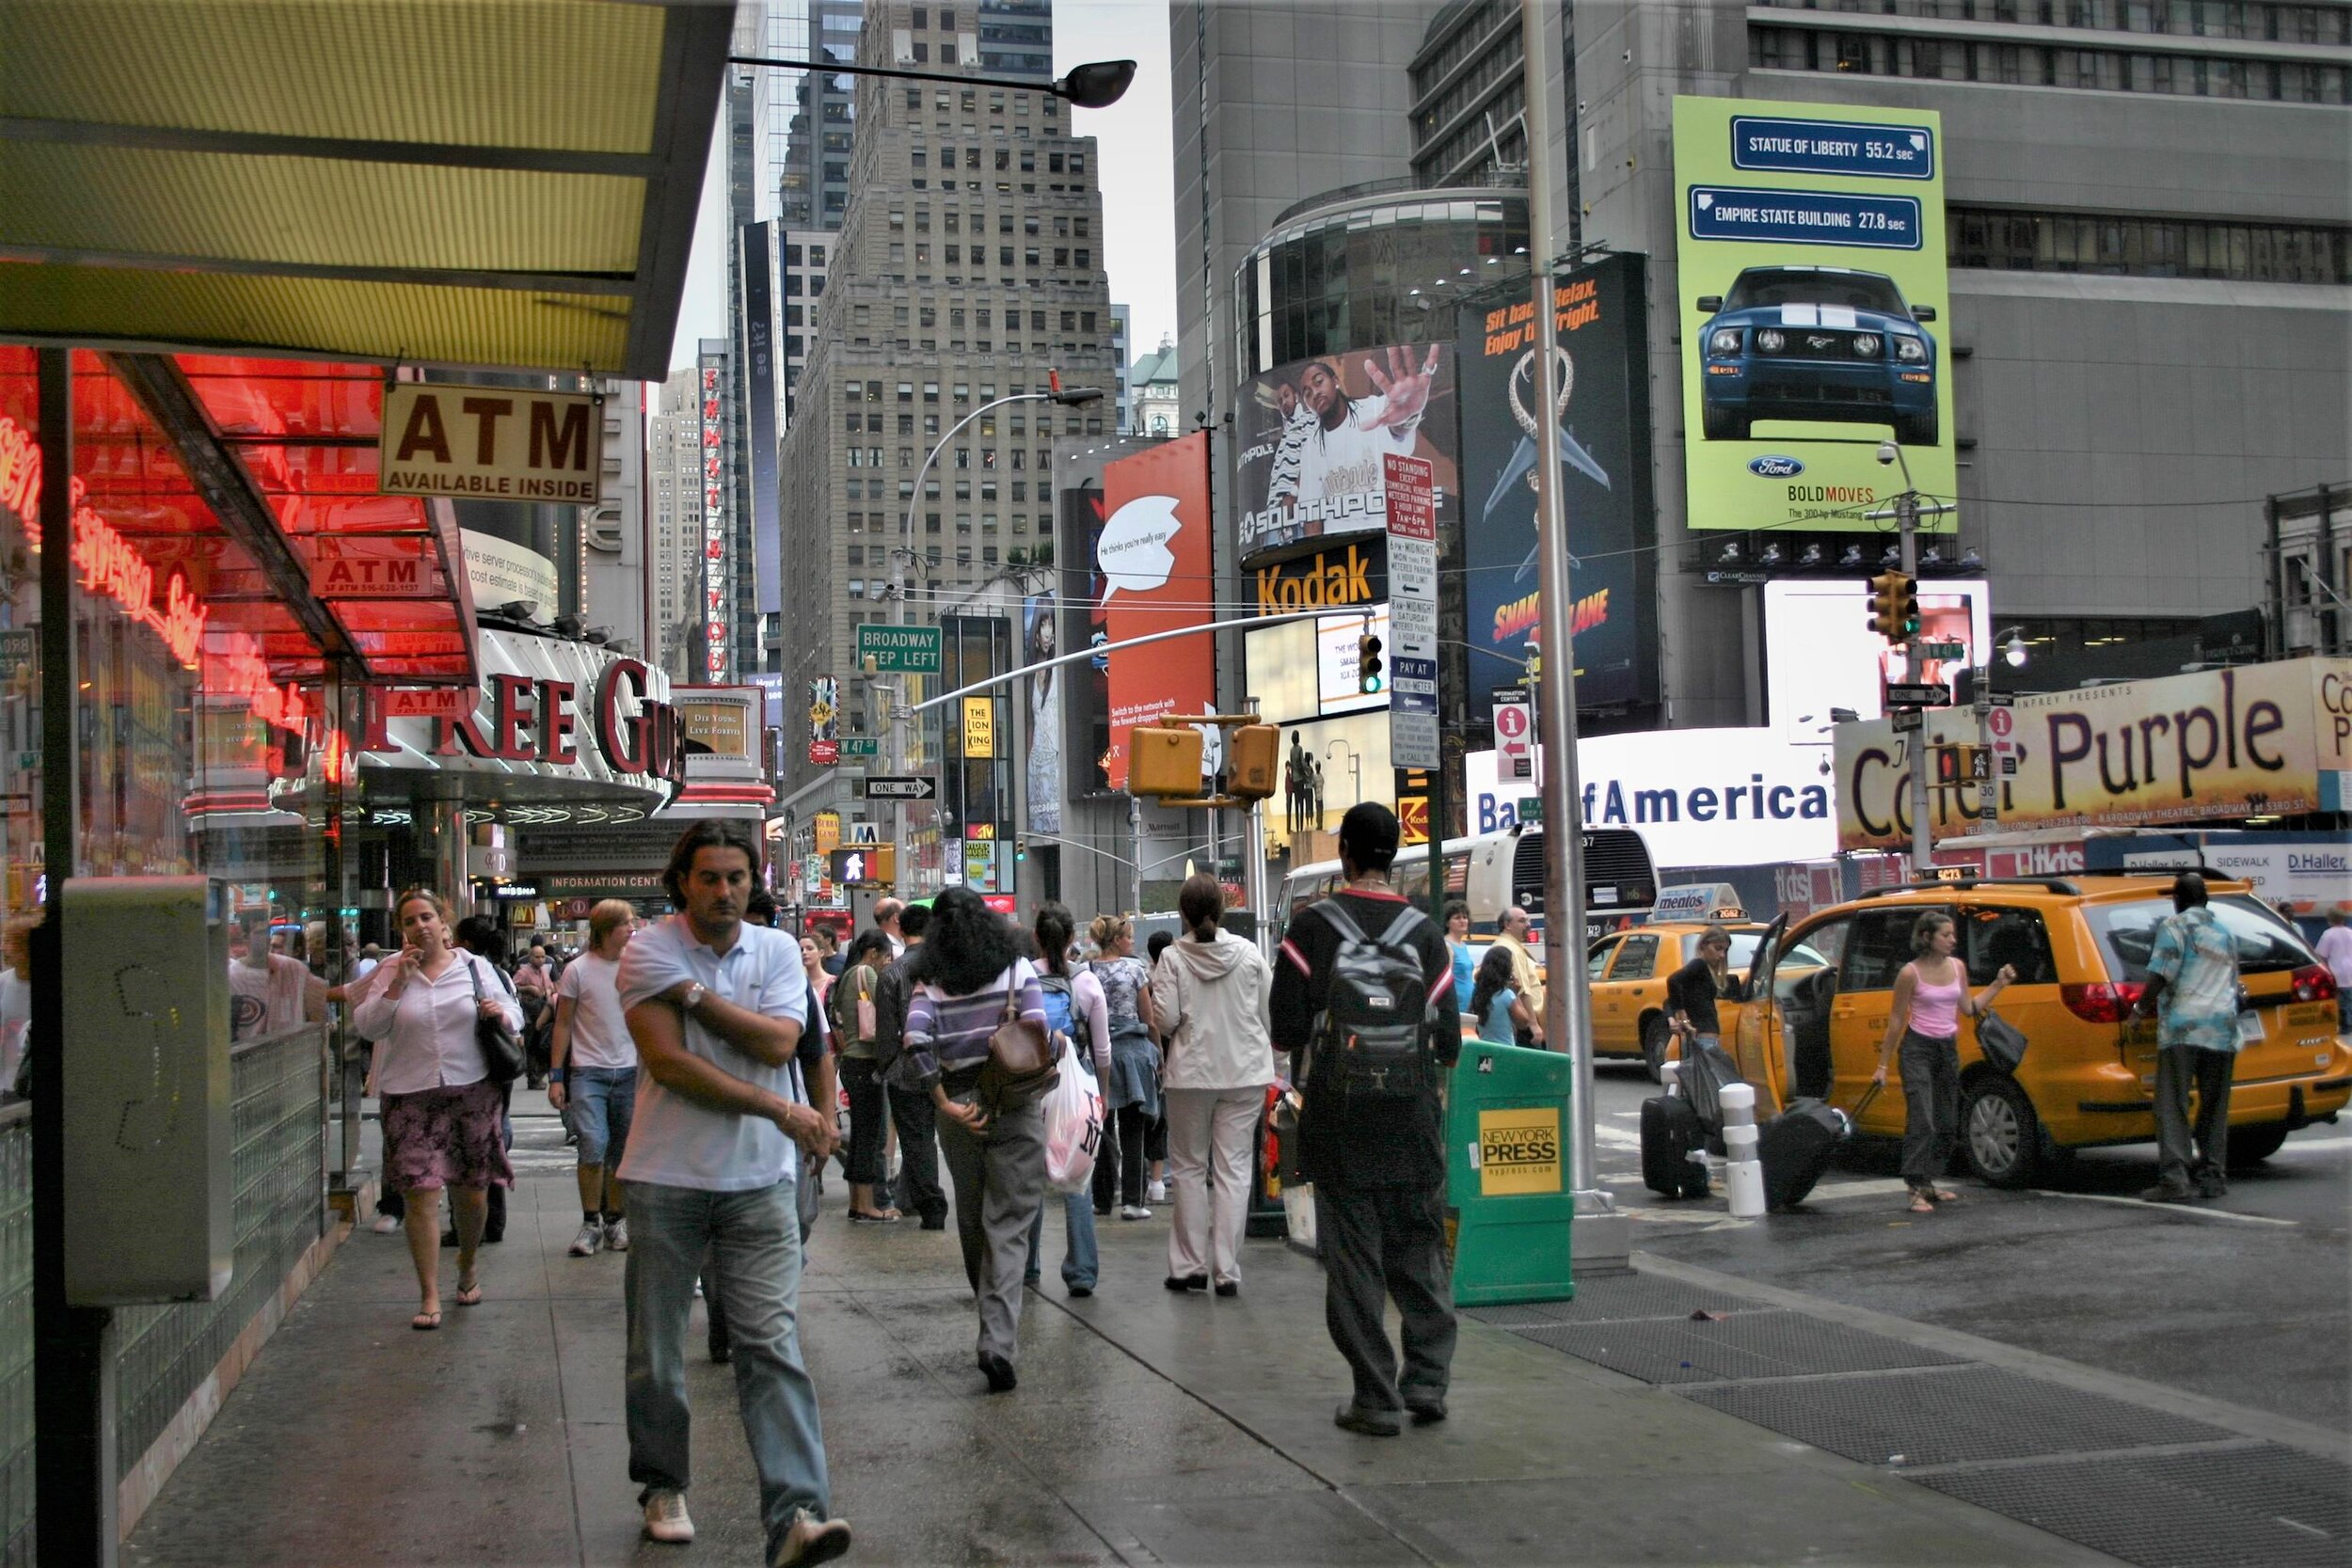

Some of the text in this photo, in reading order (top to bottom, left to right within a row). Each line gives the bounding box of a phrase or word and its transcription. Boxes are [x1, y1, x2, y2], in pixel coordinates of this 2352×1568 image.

[1749, 137, 1914, 161] STATUE OF LIBERTY 55.2 sec
[1715, 207, 1905, 230] EMPIRE STATE BUILDING 27.8 sec
[1486, 308, 1506, 333] Sit
[1509, 302, 1534, 325] bac
[1485, 327, 1522, 356] Enjoy
[396, 395, 590, 471] ATM
[1387, 459, 1428, 477] NO STANDING
[1758, 457, 1793, 476] Ford
[389, 472, 593, 499] AVAILABLE INSIDE
[1399, 473, 1418, 484] EXCEPT
[1411, 495, 1431, 506] PARKING
[1256, 486, 1443, 535] SOUTHPOE
[1398, 502, 1412, 512] HOUR
[1413, 504, 1425, 515] LIMIT
[1788, 508, 1803, 517] The
[1831, 510, 1863, 522] Mustang
[1392, 523, 1406, 532] MON
[1420, 528, 1430, 537] FRI
[1101, 546, 1108, 556] He
[1109, 542, 1124, 554] thinks
[1139, 532, 1154, 546] really
[1154, 531, 1167, 542] easy
[482, 553, 506, 568] server
[1392, 553, 1407, 562] MON
[329, 561, 417, 583] ATM
[470, 569, 487, 583] cost
[489, 575, 517, 593] estimate
[1258, 545, 1374, 617] Kodak
[1397, 612, 1429, 624] SATURDAY
[1492, 591, 1541, 643] SNAK
[1569, 588, 1609, 638] ANE
[707, 590, 726, 673] YOU
[864, 632, 935, 648] BROADWAY
[862, 651, 937, 666] KEEP LEFT
[1400, 661, 1427, 675] PAY AT
[1394, 678, 1432, 693] MUNI-METER
[397, 692, 456, 707] ATM
[1895, 690, 1913, 700] ONE
[2017, 686, 2132, 710] INFREY PRESENTS
[970, 708, 986, 718] THE
[1112, 705, 1128, 717] Switch
[1135, 704, 1143, 713] the
[1143, 702, 1164, 711] network
[1164, 698, 1176, 708] with
[967, 720, 989, 734] LION
[1112, 712, 1159, 727] the fewest dropped
[841, 740, 848, 753] W
[851, 739, 864, 753] 47
[967, 735, 990, 749] KING
[2047, 671, 2284, 810] Purple
[875, 783, 926, 794] ONE WAY
[1980, 785, 1994, 797] 30
[1478, 773, 1828, 835] Ba f America
[2201, 804, 2252, 816] BROADWAY
[2266, 801, 2290, 811] 53RD
[2294, 799, 2305, 810] ST
[1581, 836, 1595, 847] 37
[2034, 844, 2084, 874] tkts
[2217, 857, 2270, 867] SIDEWALK
[552, 877, 661, 888] INFORMATION CENT
[1774, 866, 1809, 902] tkts
[1659, 895, 1704, 910] mentos
[1484, 1142, 1556, 1163] PRESS
[1488, 1165, 1551, 1177] nypress.com
